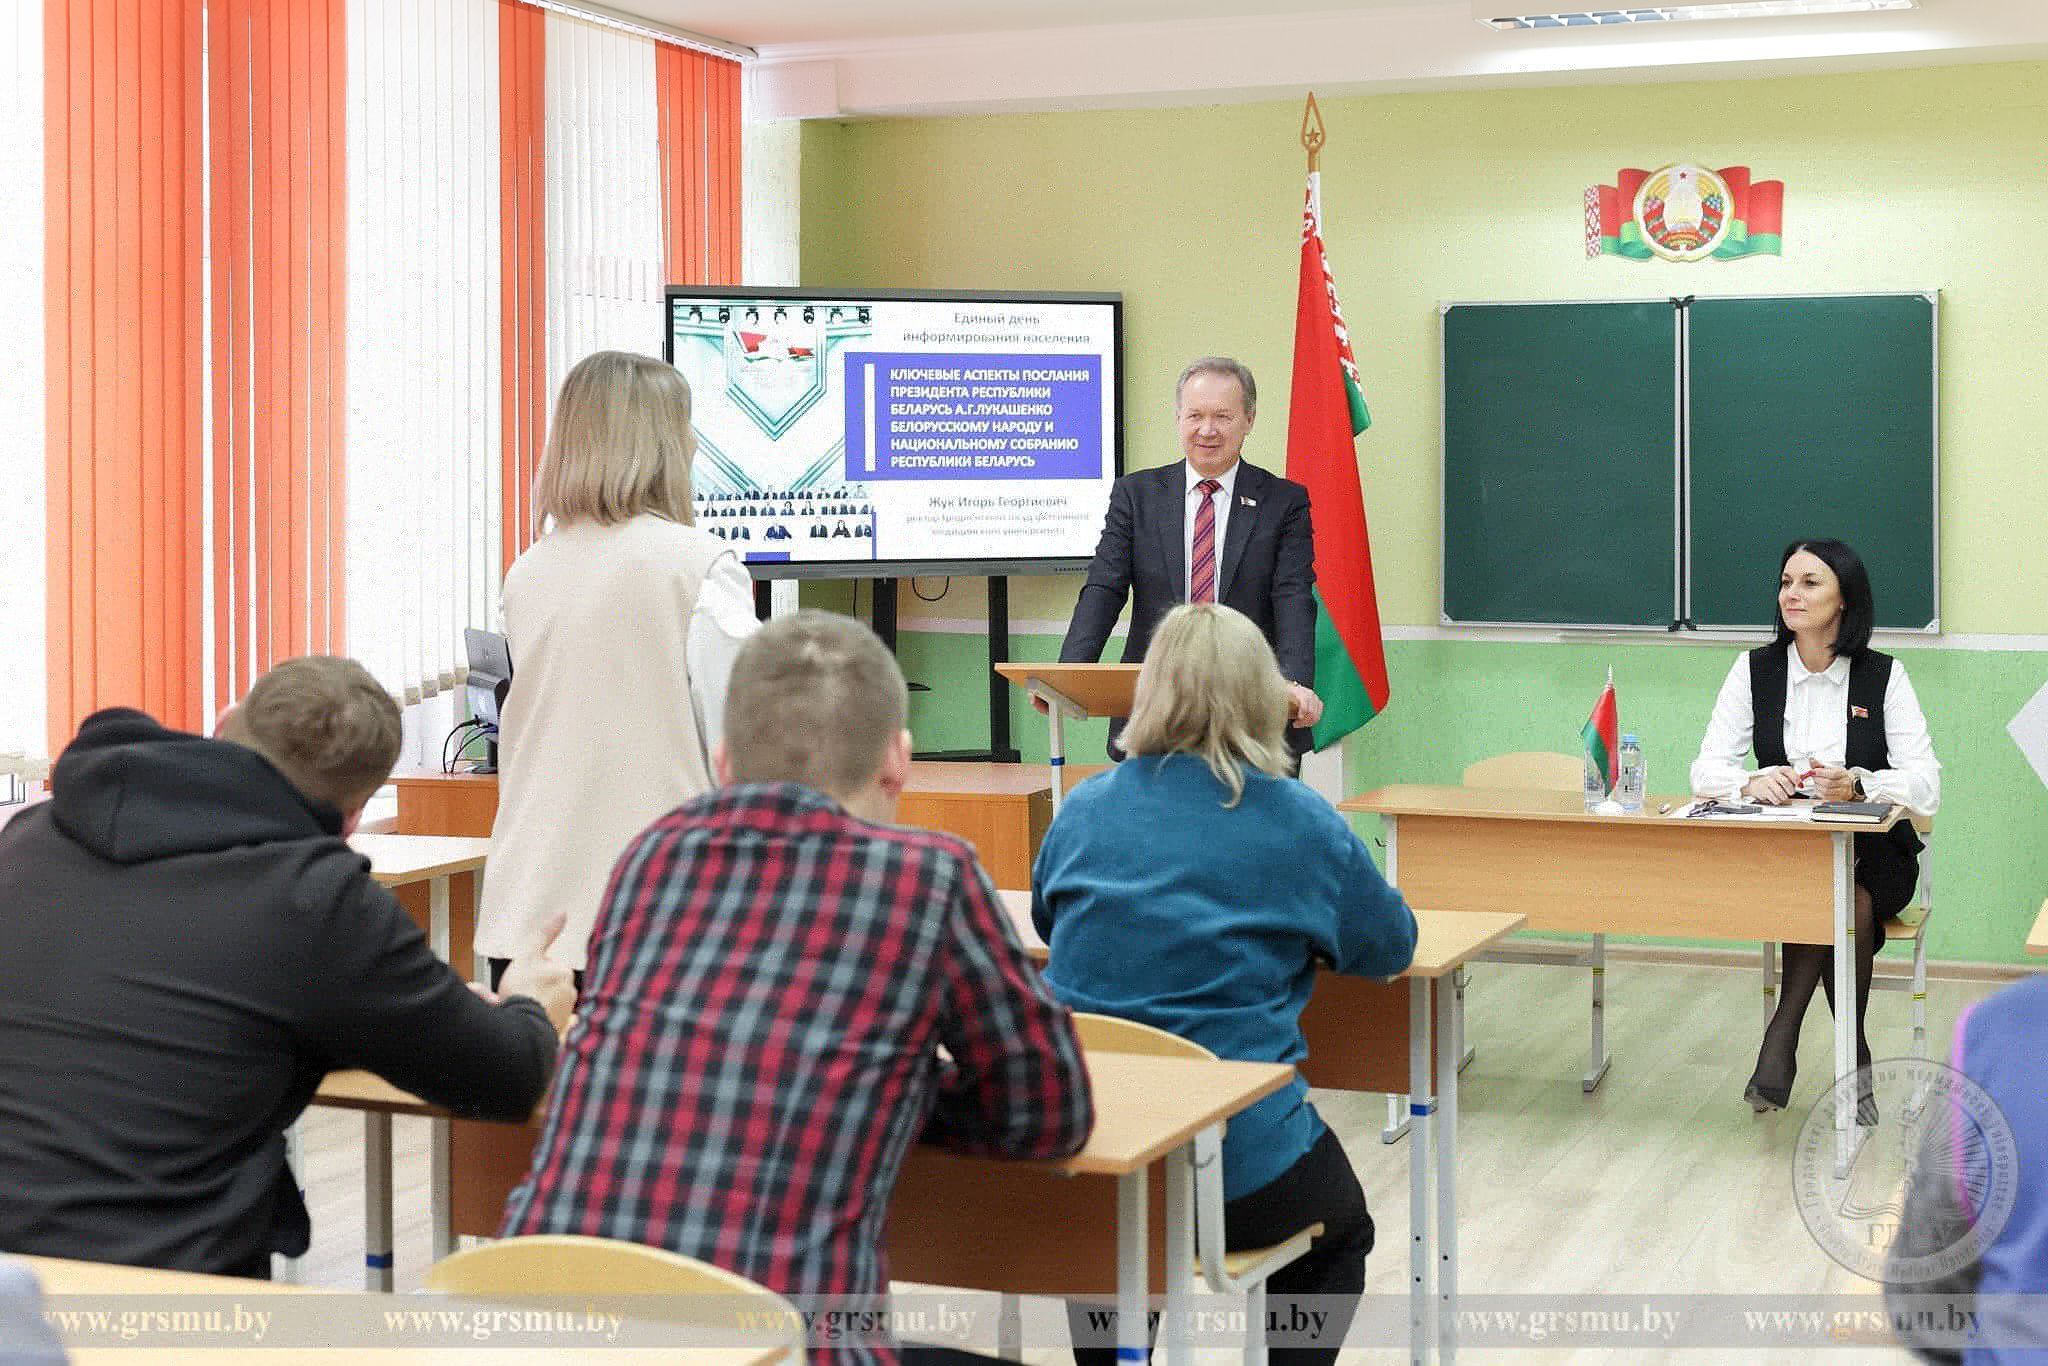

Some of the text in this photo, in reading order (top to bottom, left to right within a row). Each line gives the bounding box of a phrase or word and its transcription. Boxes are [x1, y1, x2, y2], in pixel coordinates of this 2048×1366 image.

[954, 312, 1040, 326] Единый день
[903, 330, 1090, 344] информирования населения
[890, 368, 1089, 382] КЛЮЧЕВЫЕ АСПЕКТЫ ПОСЛАНИЯ
[890, 386, 1051, 400] ПРЕЗИДЕНТА РЕСПУБЛИКИ
[890, 403, 1053, 416] БЕЛАРУСЬ А.Г.ЛУКАШЕНКО
[890, 421, 1054, 434] БЕЛОРУССКОМУ НАРОДУ И
[891, 438, 1079, 451] НАЦИОНАЛЬНОМУ СОБРАНИЮ
[891, 455, 1036, 467] РЕСПУБЛИКИ БЕЛАРУСЬ
[929, 496, 954, 509] Жук
[958, 496, 995, 509] Игорь
